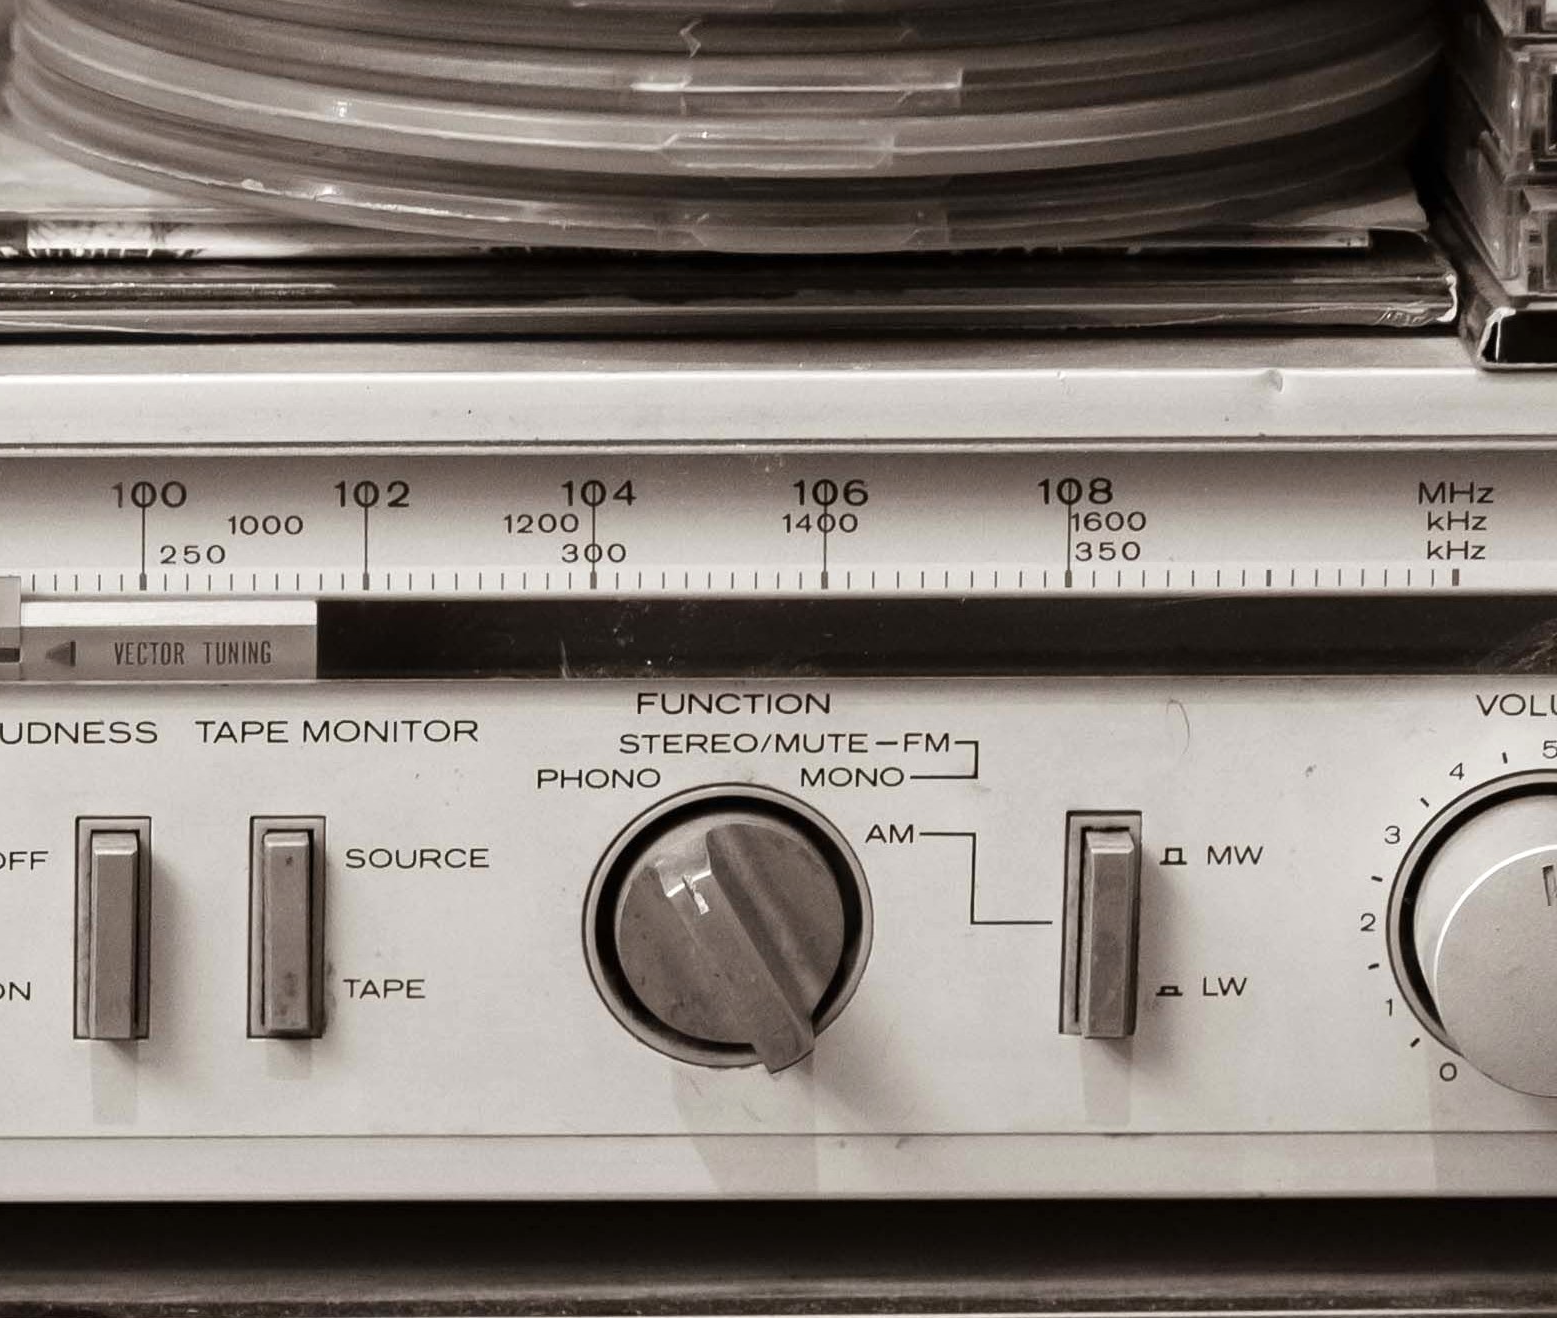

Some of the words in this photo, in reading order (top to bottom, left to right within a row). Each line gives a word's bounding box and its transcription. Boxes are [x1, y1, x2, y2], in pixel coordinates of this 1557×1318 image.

[112, 482, 188, 508] 100
[334, 481, 410, 508] 102
[560, 480, 637, 507] 104
[792, 480, 869, 507] 106
[1037, 478, 1114, 505] 108
[1418, 481, 1494, 505] MHz
[228, 515, 304, 535] 1000
[503, 514, 579, 534] 1200
[782, 513, 859, 534] 1400
[1070, 511, 1147, 532] 1600
[1427, 512, 1487, 532] kHz
[160, 545, 226, 565] 250
[561, 543, 627, 564] 300
[1075, 541, 1141, 562] 350
[1427, 541, 1486, 561] kHz
[113, 641, 185, 666] VECTOR
[204, 641, 273, 665] TUNING
[637, 691, 831, 715] FUNCTION
[194, 720, 289, 744] TAPE
[303, 719, 478, 743] MONITOR
[619, 732, 869, 755] STEREO/MUTE
[902, 733, 951, 754] FM
[537, 768, 661, 789] PHONO
[800, 767, 905, 789] MONO
[1449, 762, 1465, 781] 4
[865, 824, 915, 845] AM
[1384, 825, 1401, 845] 3
[345, 848, 490, 870] SOURCE
[1207, 845, 1264, 865] MW
[1360, 912, 1376, 932] 2
[342, 978, 425, 999] TAPE
[1202, 976, 1248, 997] LW
[1439, 1062, 1458, 1082] 0
